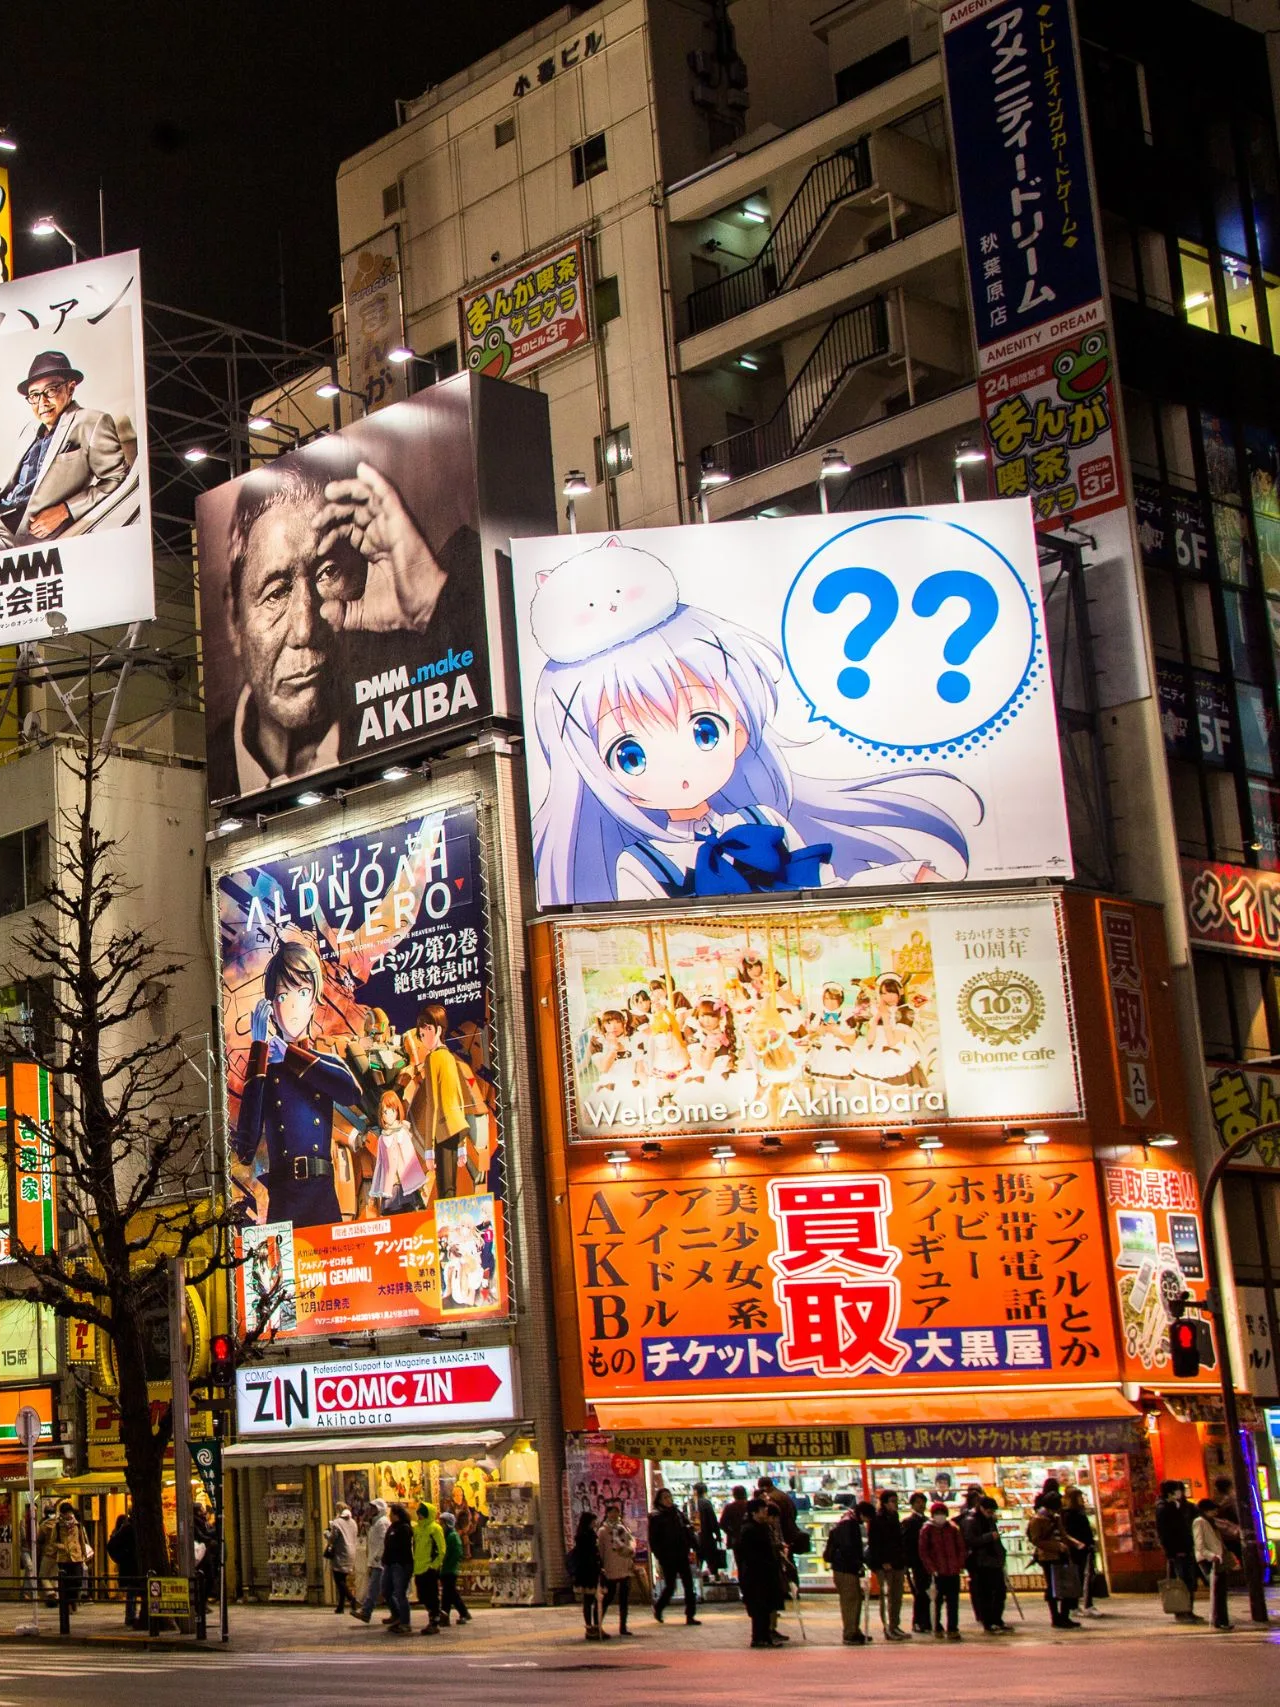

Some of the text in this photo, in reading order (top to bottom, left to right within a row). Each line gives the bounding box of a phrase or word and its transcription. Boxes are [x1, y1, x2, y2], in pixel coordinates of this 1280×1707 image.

[466, 253, 578, 340] まんが喫茶
[979, 231, 1008, 329] 秋葉原店
[986, 307, 1098, 364] AMENITY DREAM
[987, 394, 1109, 455] まんが
[995, 444, 1069, 496] 喫茶
[1083, 472, 1113, 497] 3F
[1037, 486, 1078, 518] ゲラ
[1175, 528, 1208, 570] 6F
[812, 566, 1000, 704] ??
[357, 674, 479, 747] AKIBA
[1197, 713, 1231, 756] 5F
[369, 927, 479, 976] コミック第2巻
[955, 926, 1031, 942] おかげさまで
[964, 939, 1028, 960] 10周年
[393, 956, 480, 995] 絶賛発売中!
[456, 980, 482, 994] Knights
[979, 995, 1011, 1015] 10
[958, 1046, 1056, 1065] @home cafe
[1131, 1066, 1147, 1106] 入口
[583, 1084, 946, 1130] Welcome to Akihabara
[373, 1234, 435, 1256] アンソロジー
[673, 1187, 718, 1293] アニメ
[948, 1173, 989, 1280] ホビー
[992, 1172, 1049, 1322] 携帯電話
[398, 1250, 436, 1268] コミック
[631, 1188, 679, 1329] アイドル
[715, 1183, 769, 1331] 美少女系
[901, 1177, 952, 1327] フィギュア
[1040, 1171, 1102, 1369] アップルとか
[299, 1271, 327, 1289] TWIN
[777, 1180, 908, 1370] 買取
[300, 1297, 351, 1314] 12月12日発売
[1, 1348, 28, 1367] 15席
[313, 1351, 486, 1375] Professional Support for Magazine & MANGA-ZIN
[645, 1331, 1042, 1378] チケット 大黒屋
[245, 1370, 273, 1382] COMIC
[317, 1371, 453, 1410] COMIC ZIN
[245, 1366, 310, 1428] ZIN
[317, 1411, 392, 1427] Akihabara
[748, 1431, 834, 1445] WESTERN
[669, 1435, 737, 1447] TRANSFER
[776, 1444, 835, 1456] UNION
